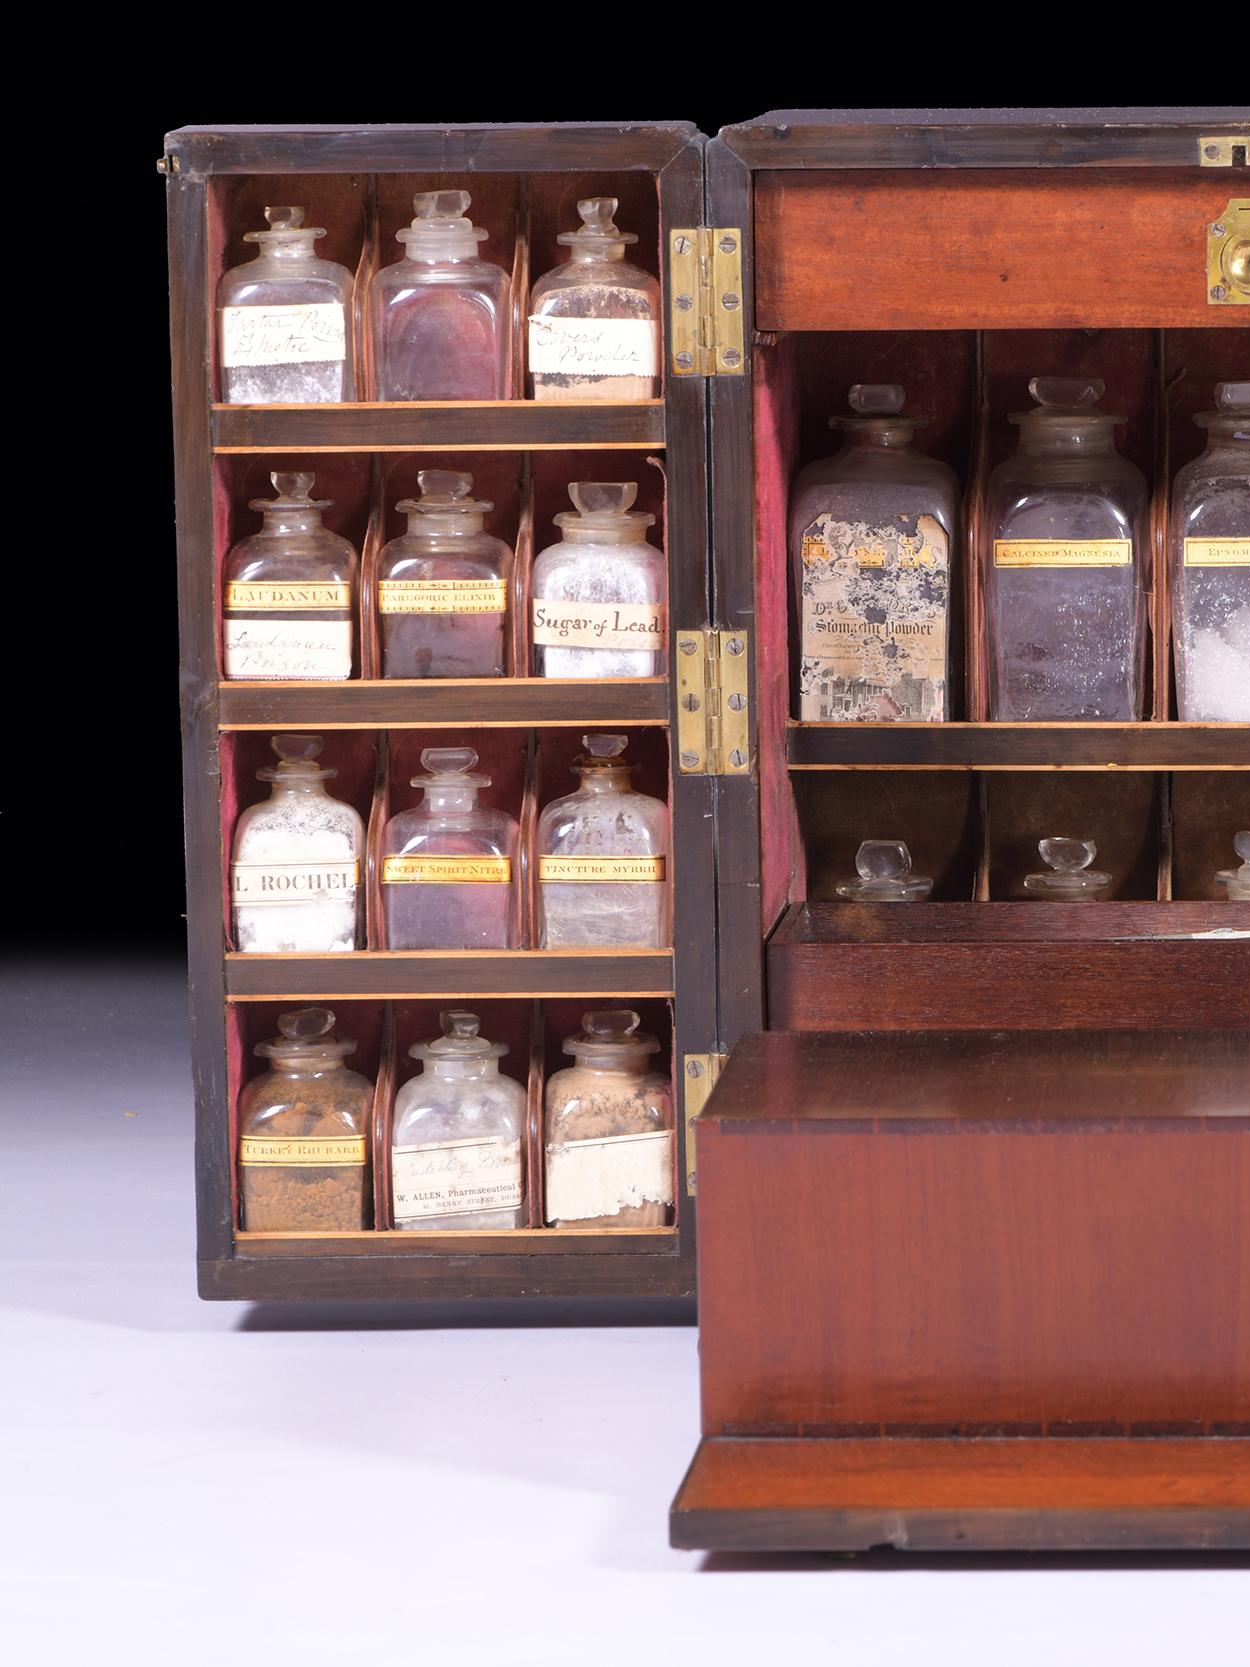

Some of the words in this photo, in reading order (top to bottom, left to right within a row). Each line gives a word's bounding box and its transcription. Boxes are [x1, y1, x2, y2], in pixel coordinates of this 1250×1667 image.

[1003, 549, 1059, 558] CALCINED
[1063, 548, 1121, 558] MAGNESIA
[1208, 548, 1250, 556] EPSOM
[233, 588, 340, 602] LAUDANUM
[382, 593, 450, 602] PAREGORIC
[453, 593, 497, 602] ELIXIR
[533, 608, 592, 637] Sugar
[593, 619, 608, 637] of
[885, 620, 935, 637] Powder
[386, 865, 425, 874] SWEET
[429, 865, 468, 875] SPIRIT
[546, 865, 607, 874] TINCTURE
[612, 865, 656, 874] MYRRH
[244, 1144, 293, 1155] TURKEY
[397, 1195, 410, 1203] W.
[448, 1183, 516, 1198] Pharmaceutical
[436, 1200, 462, 1208] HENRY
